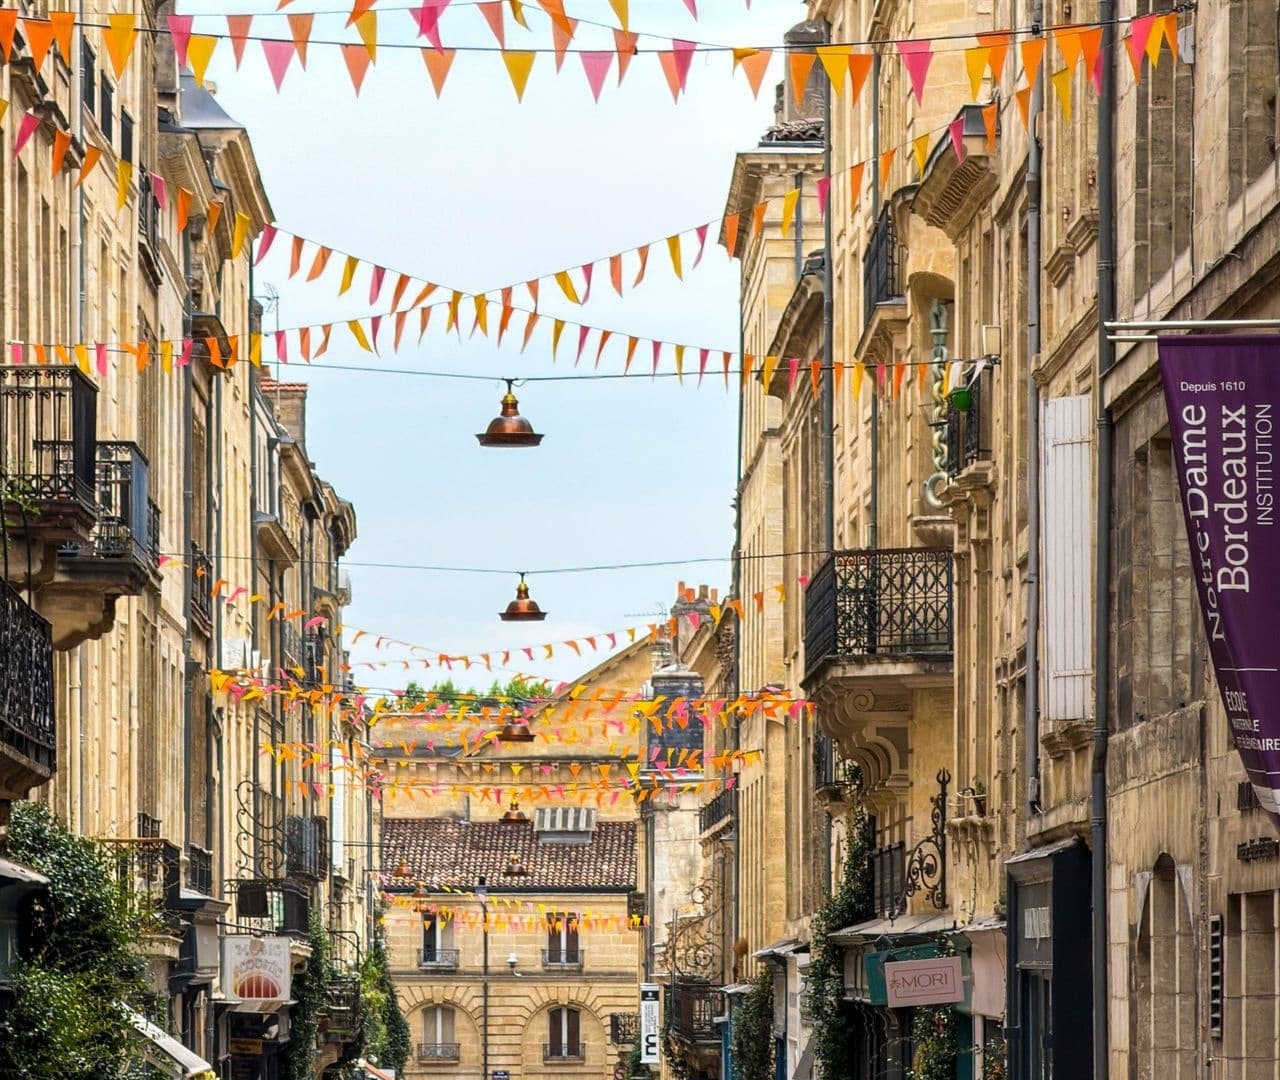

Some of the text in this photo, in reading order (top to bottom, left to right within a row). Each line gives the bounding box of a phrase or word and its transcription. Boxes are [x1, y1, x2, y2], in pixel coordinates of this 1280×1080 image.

[1180, 381, 1246, 393] Depuis 1610
[1182, 404, 1226, 642] Notre-Dame
[1214, 404, 1249, 593] Bordeaux
[1255, 404, 1274, 526] INSTITUTION
